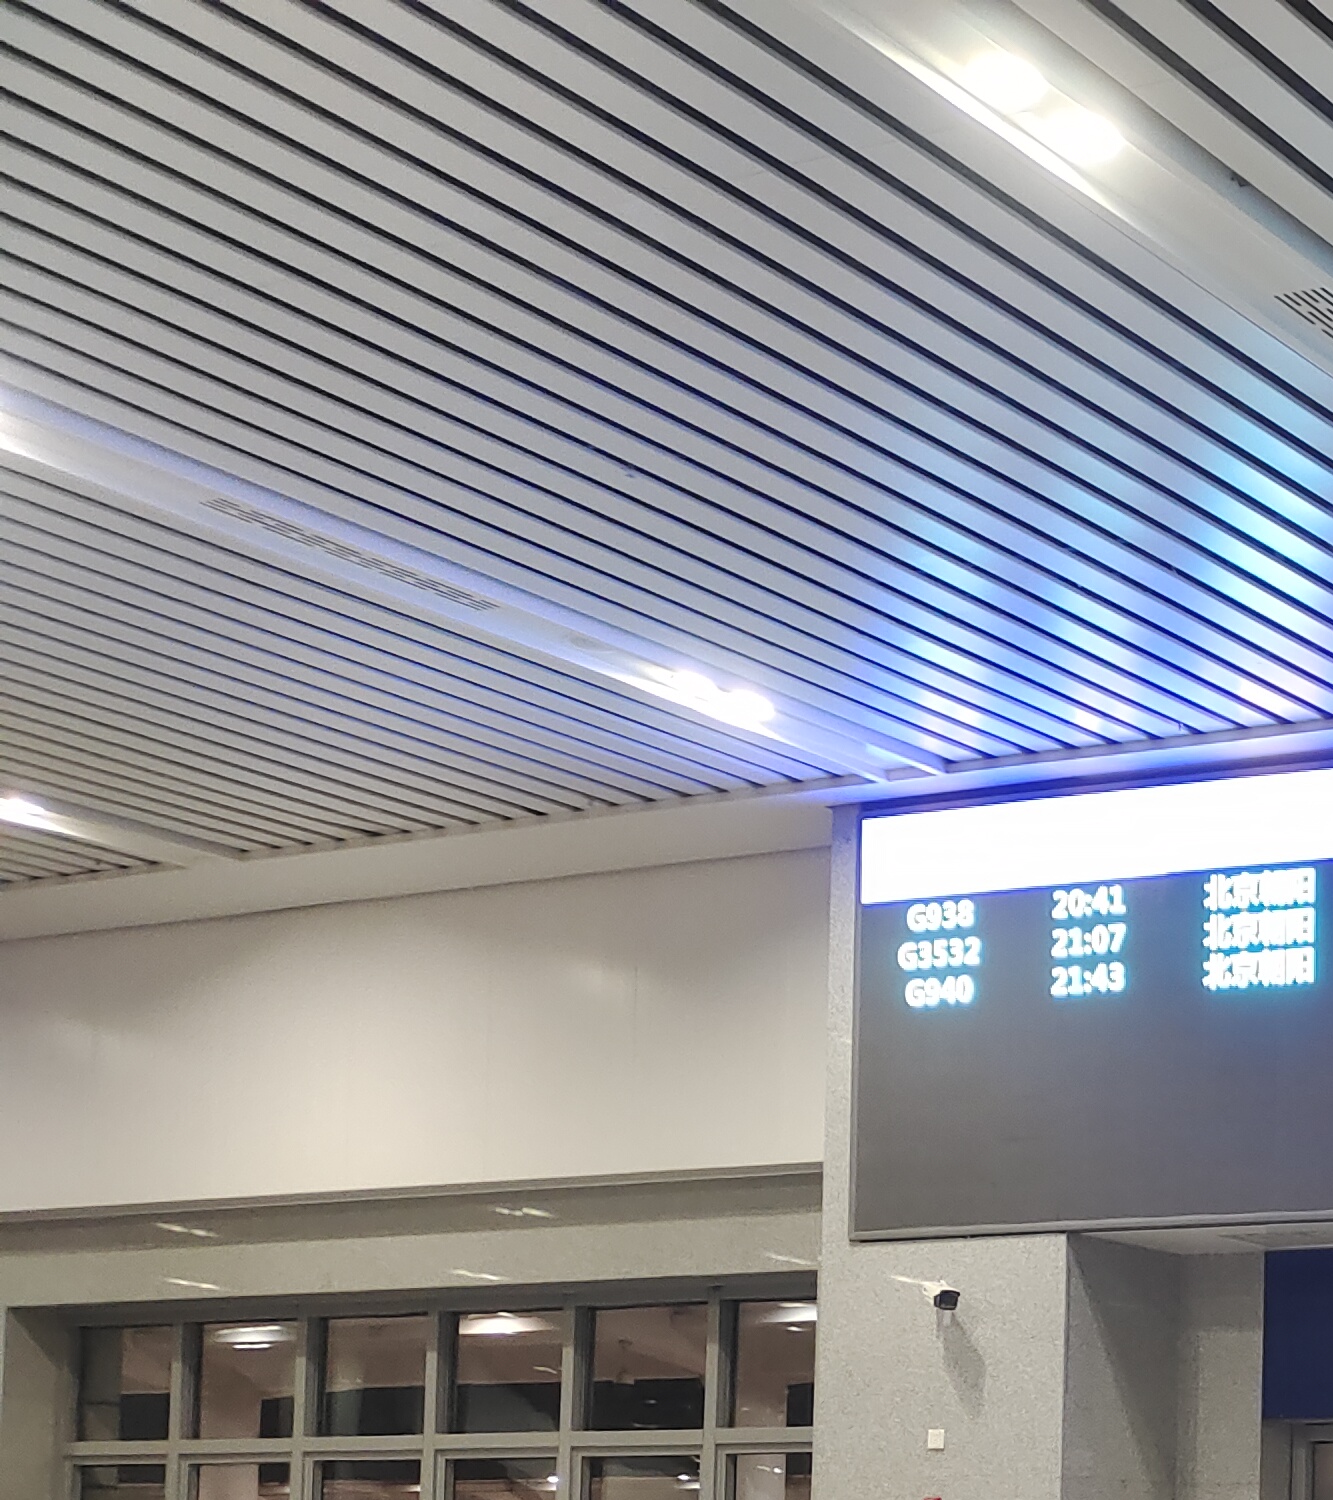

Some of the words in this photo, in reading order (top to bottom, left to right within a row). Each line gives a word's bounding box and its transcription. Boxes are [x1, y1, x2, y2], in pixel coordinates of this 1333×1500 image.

[907, 899, 974, 932] G938
[1051, 884, 1126, 920] 20:41
[897, 936, 981, 970] G3532
[1051, 922, 1126, 958] 21:07
[905, 975, 974, 1008] G940
[1050, 962, 1126, 997] 21:43
